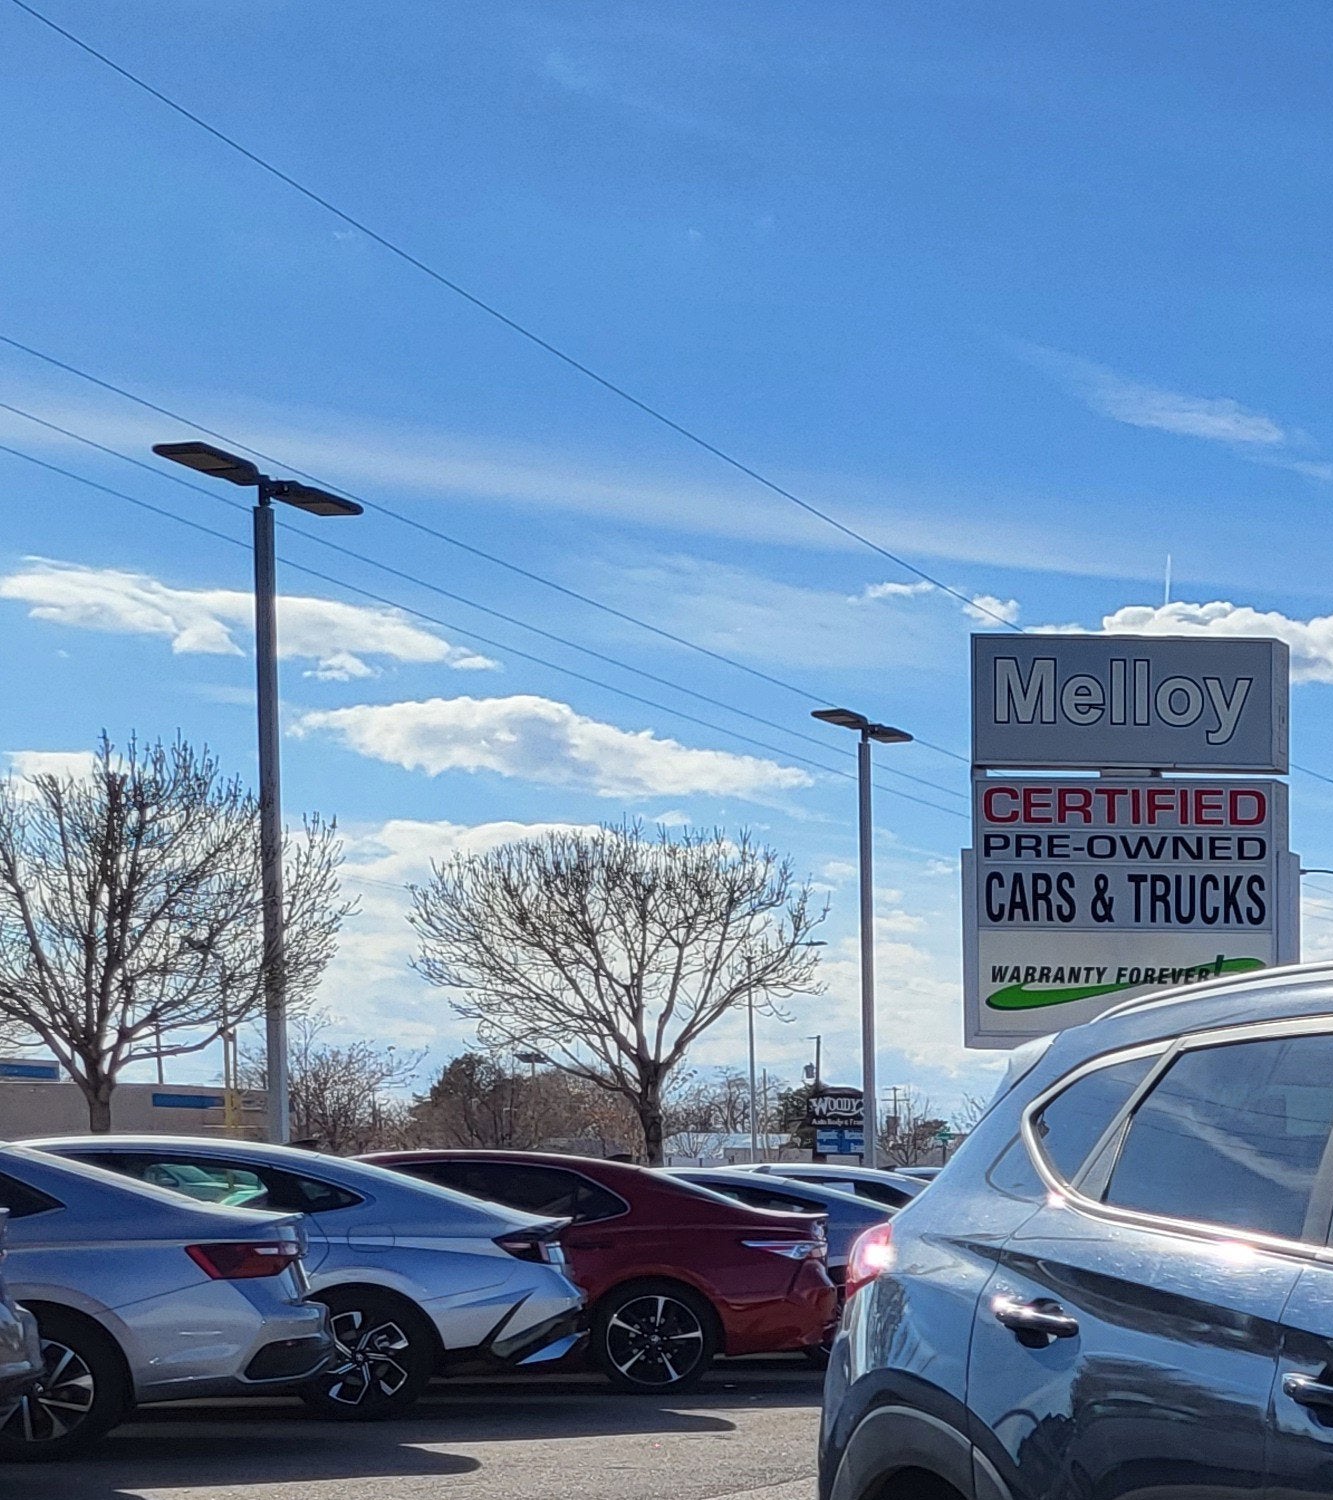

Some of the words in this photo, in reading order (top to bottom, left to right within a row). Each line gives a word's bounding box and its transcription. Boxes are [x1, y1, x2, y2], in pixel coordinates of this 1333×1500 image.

[994, 657, 1253, 745] Melloy
[983, 787, 1266, 826] CERTIFIED
[983, 833, 1267, 861] PRE-OWNED
[985, 872, 1076, 923] CARS
[1091, 874, 1114, 923] &
[1127, 874, 1266, 925] TRUCKS
[991, 965, 1108, 984] WARRANTY
